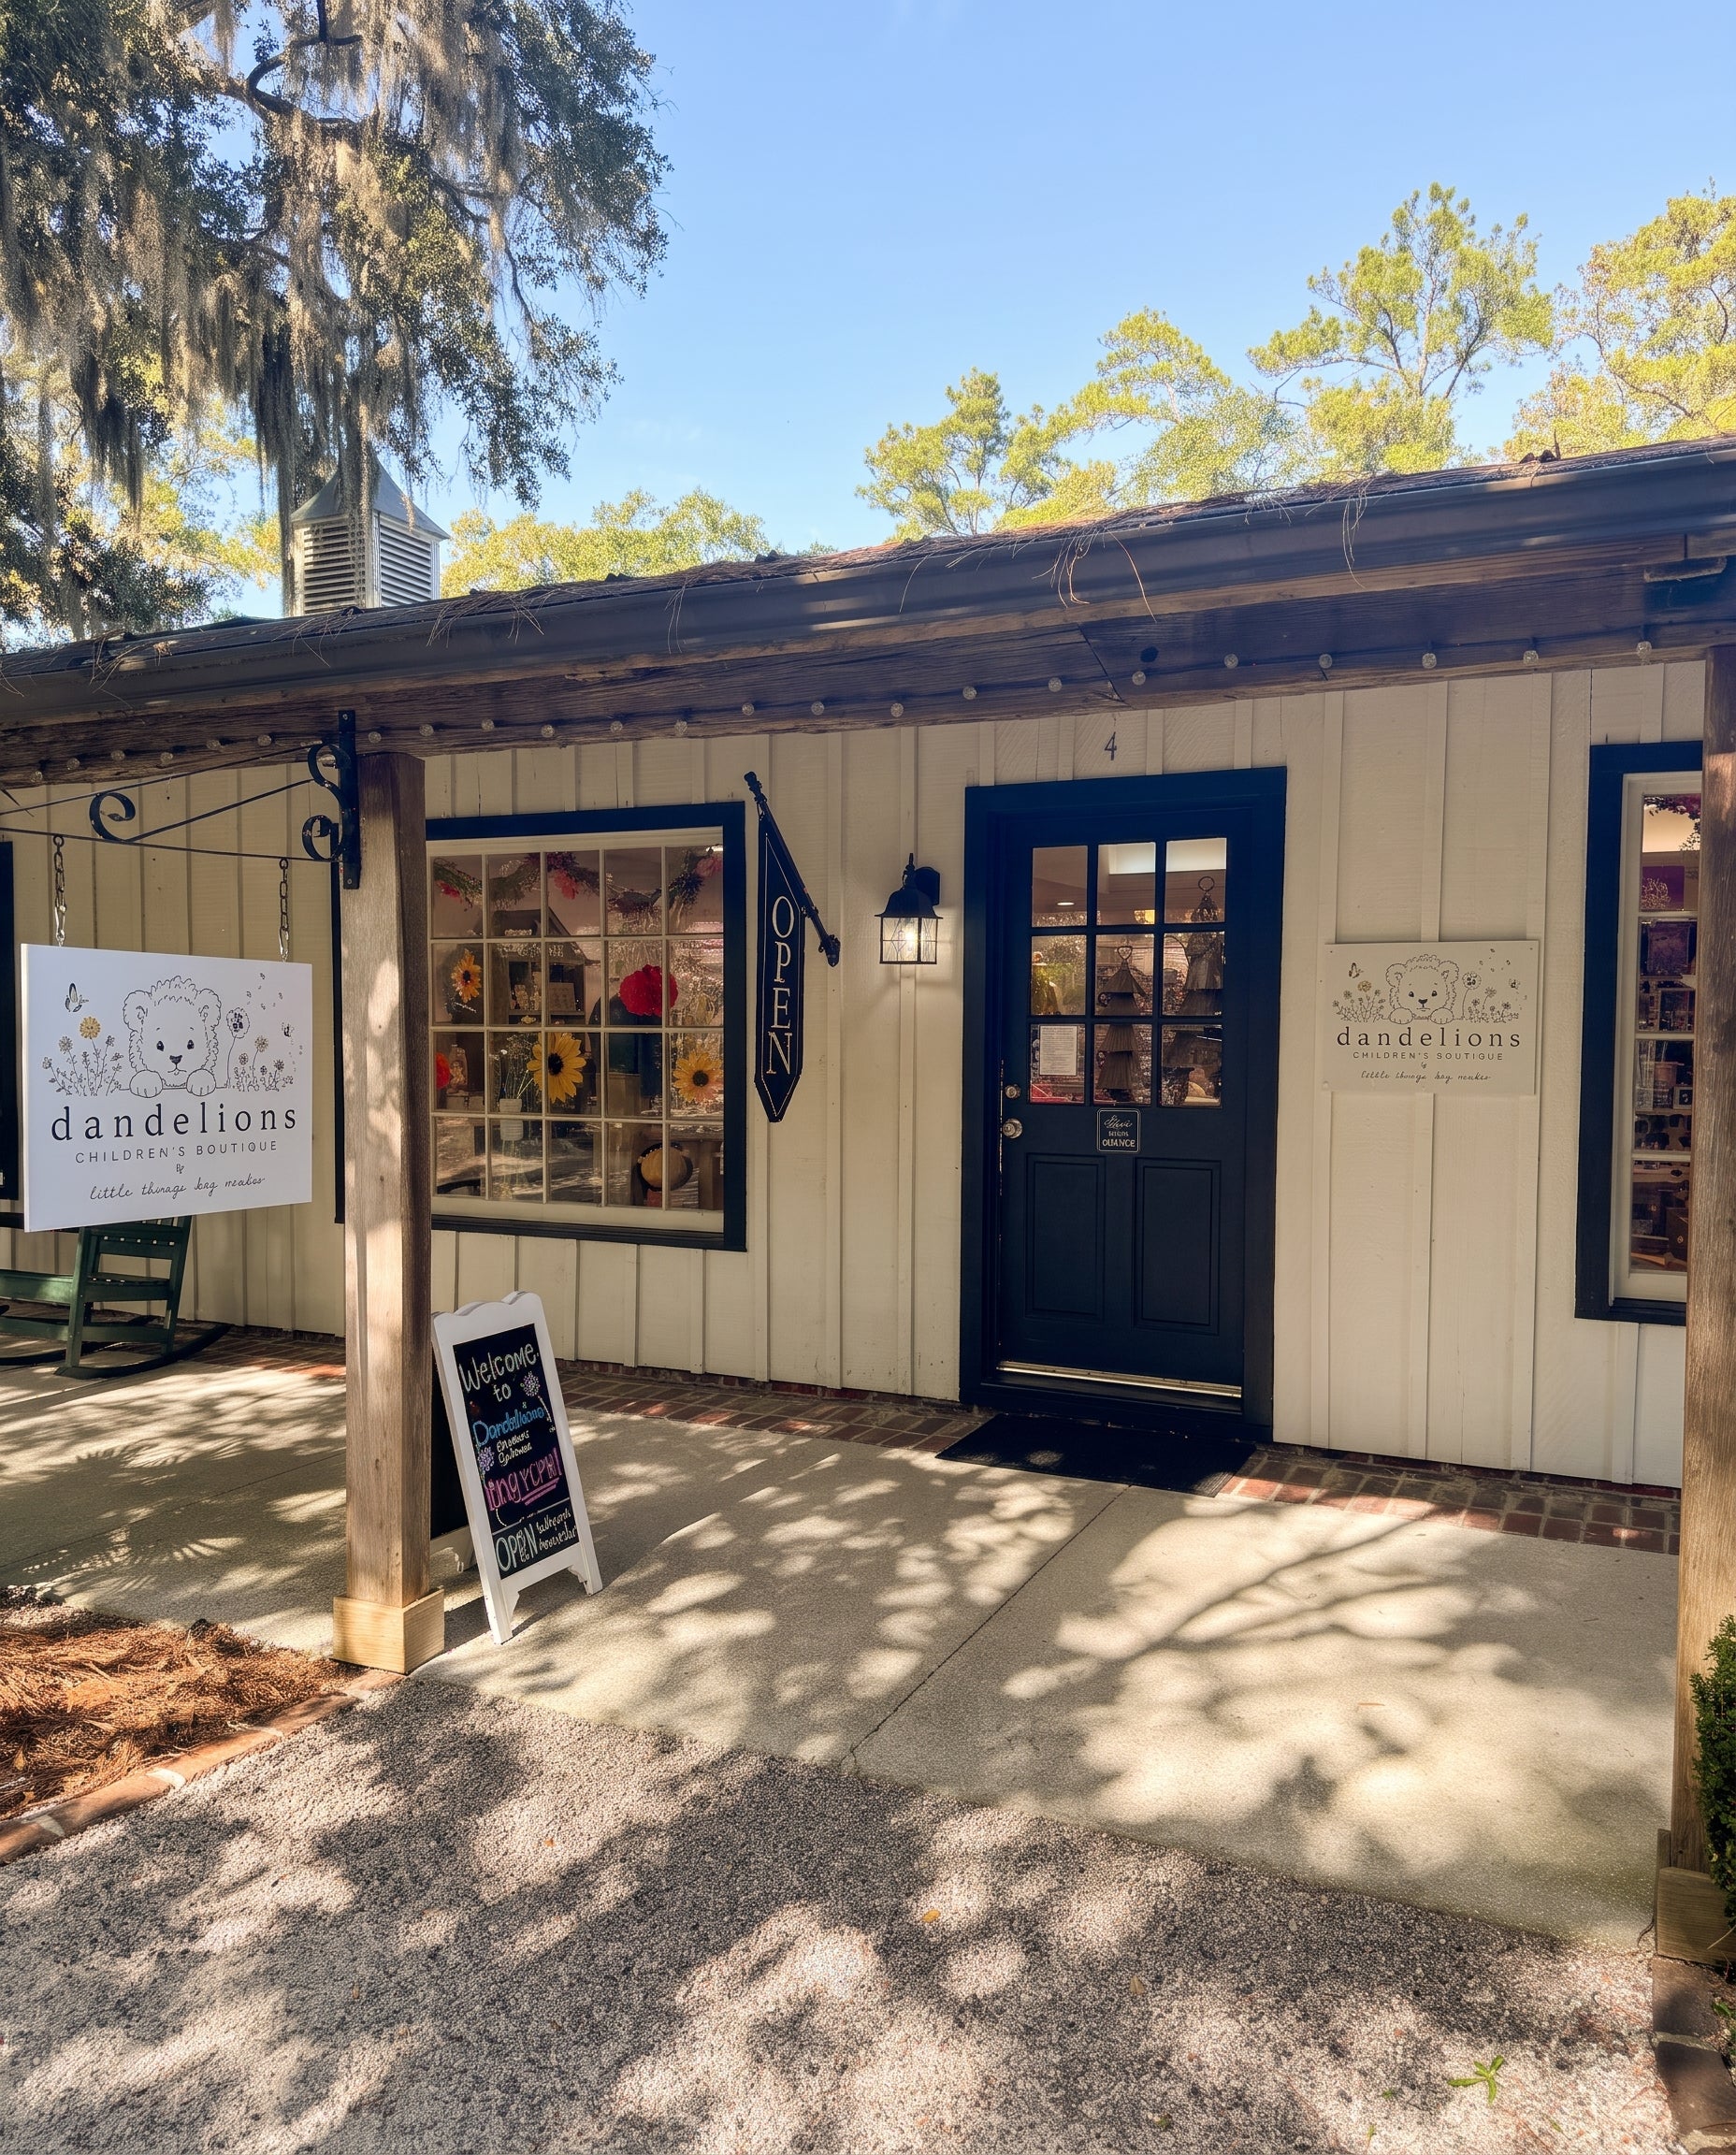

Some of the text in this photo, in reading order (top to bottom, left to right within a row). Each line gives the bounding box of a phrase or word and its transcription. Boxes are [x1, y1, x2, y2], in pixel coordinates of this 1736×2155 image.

[1105, 731, 1117, 760] 4
[766, 895, 795, 1075] OPEN
[1337, 1027, 1520, 1048] dandelions
[51, 1101, 297, 1141] dandelions
[75, 1140, 278, 1164] CHILDREN'S BOUTIQUE
[493, 1383, 512, 1402] to
